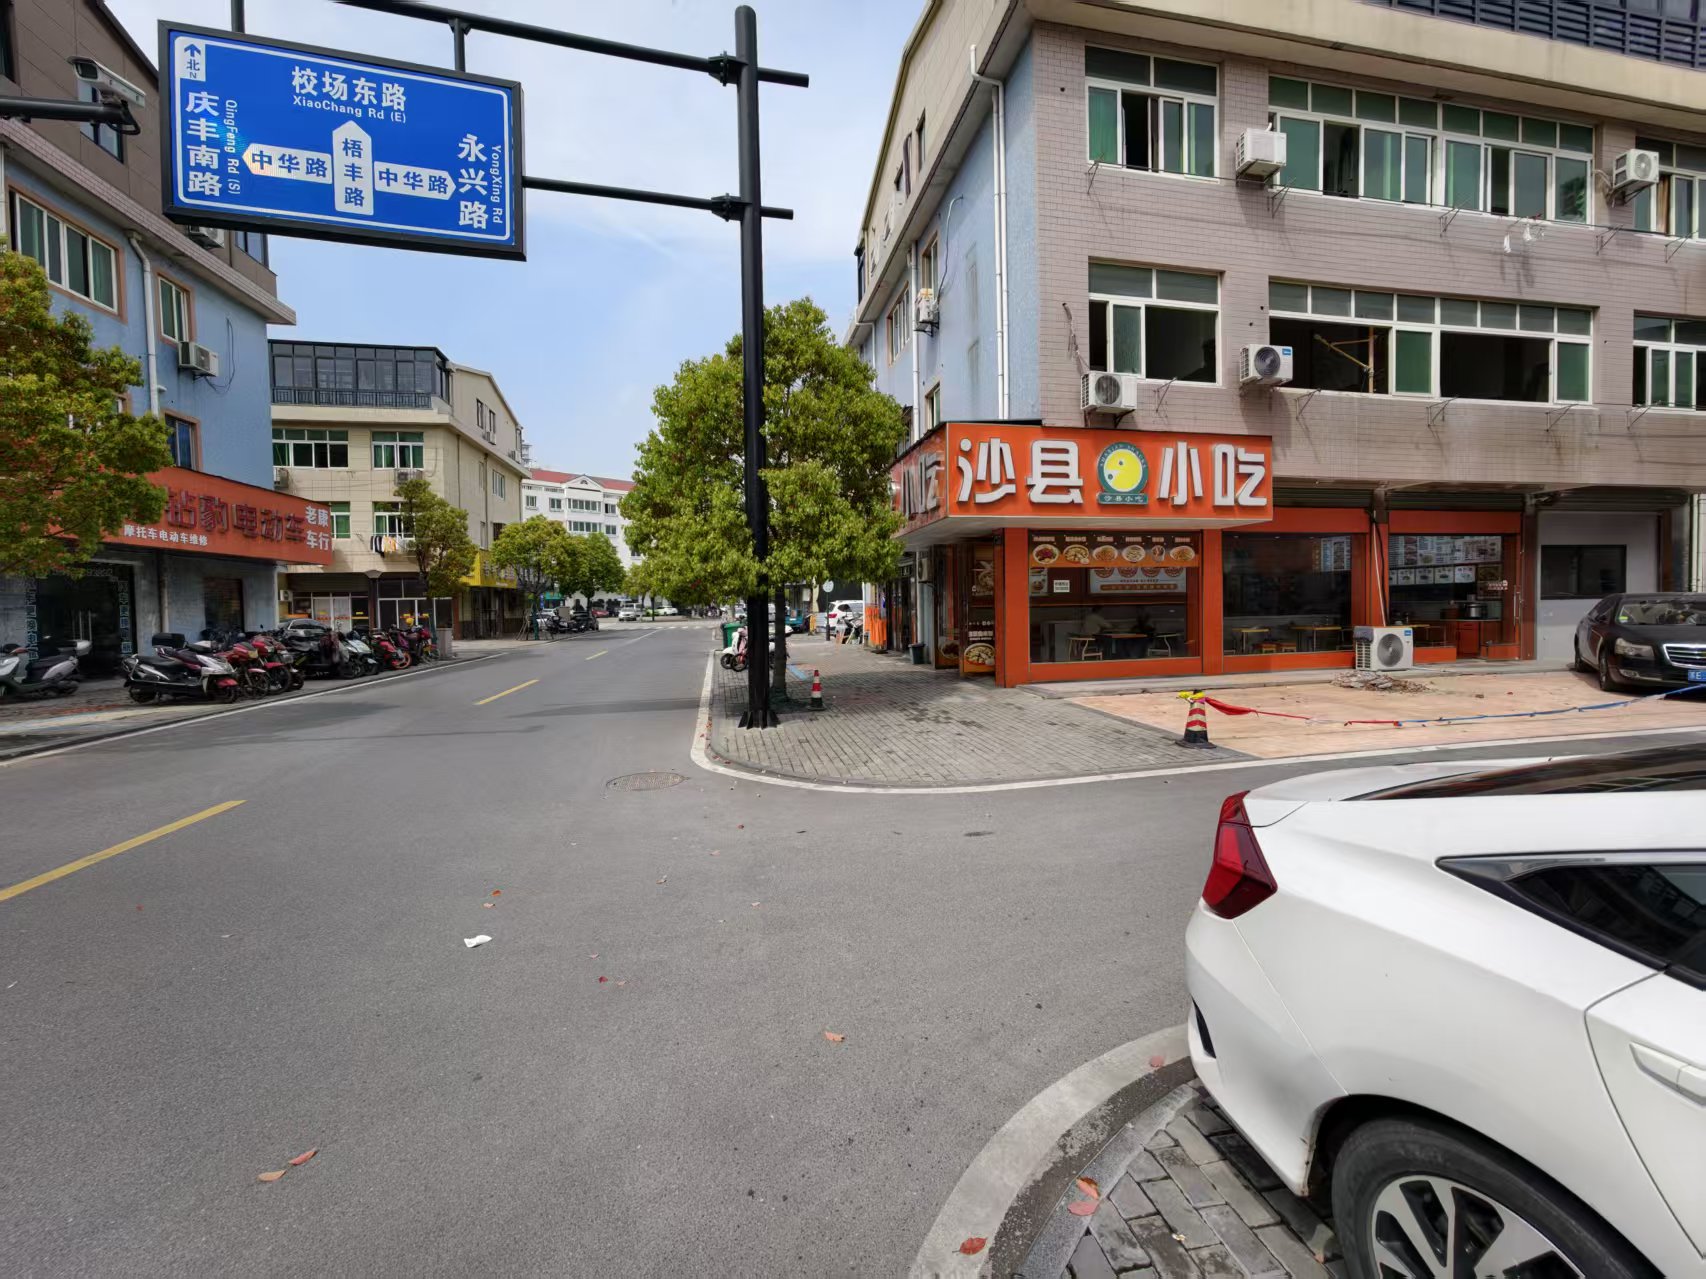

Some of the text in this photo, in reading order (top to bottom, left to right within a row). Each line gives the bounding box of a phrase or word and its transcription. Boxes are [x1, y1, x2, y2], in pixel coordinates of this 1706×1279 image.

[186, 58, 201, 72] 北
[190, 71, 197, 80] N
[292, 65, 407, 112] 校场东路
[292, 95, 407, 124] XiaoChang Rd (E)
[185, 91, 223, 198] 庆丰南路
[224, 99, 241, 195] QingFeng Rd (S)
[251, 149, 328, 180] 中华路
[341, 138, 365, 208] 梧丰路
[378, 166, 450, 195] 中华路
[457, 133, 489, 231] 永兴路
[490, 144, 503, 225] YongXing Rd
[957, 437, 1269, 507] 沙县 小吃
[305, 505, 329, 528] 老康
[123, 524, 208, 546] 摩托车电动车维修
[305, 529, 330, 551] 车行
